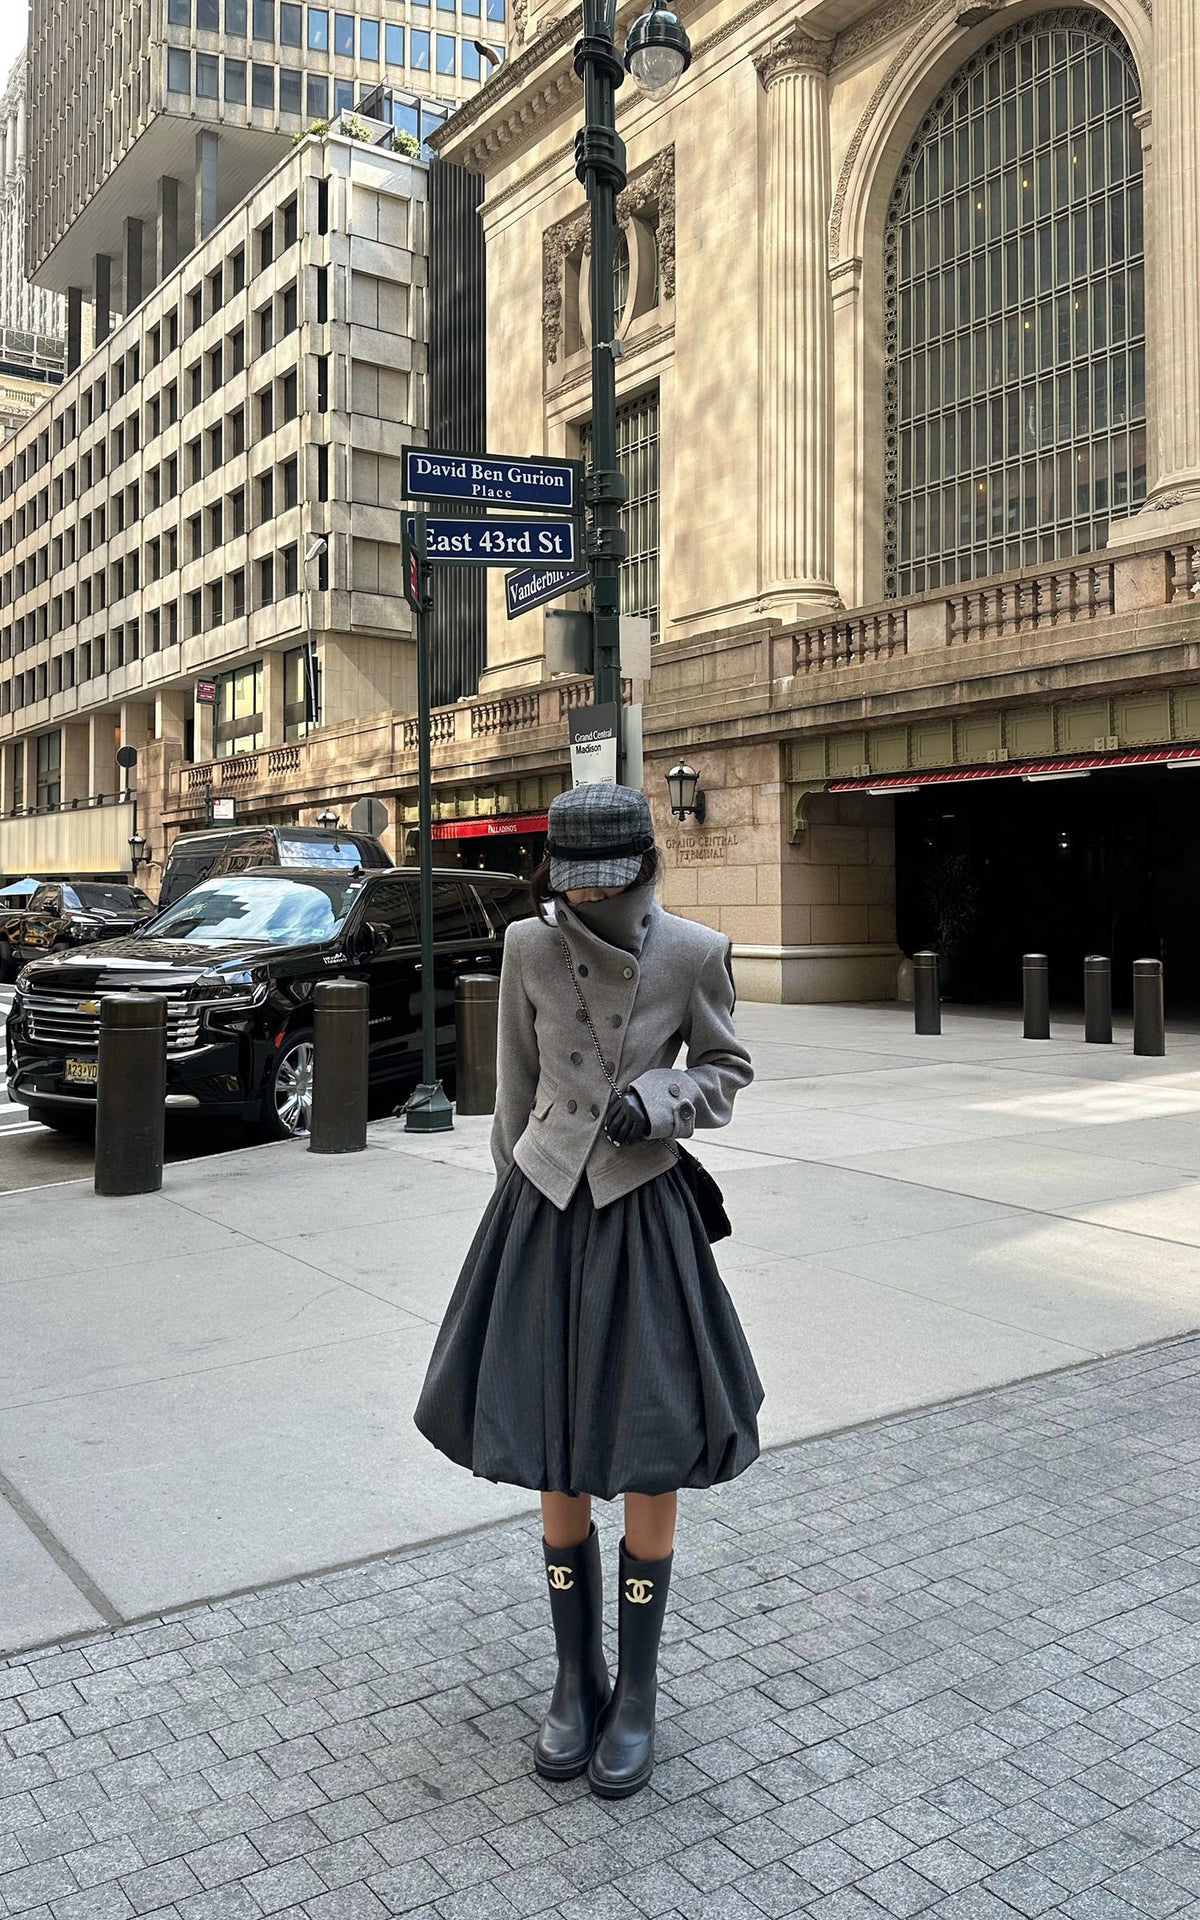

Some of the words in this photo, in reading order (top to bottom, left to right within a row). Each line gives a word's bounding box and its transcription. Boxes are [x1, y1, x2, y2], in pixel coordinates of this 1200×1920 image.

[416, 459, 467, 478] David
[471, 464, 504, 482] Ben
[507, 467, 564, 487] Gurion
[472, 484, 512, 498] Place
[426, 529, 472, 552] East
[479, 531, 532, 553] 43rd
[538, 531, 563, 553] St
[575, 732, 593, 743] Grand
[593, 728, 612, 740] Central
[575, 744, 602, 755] Madison
[665, 837, 696, 849] GRAND
[698, 834, 739, 847] CENTRAL
[679, 848, 725, 862] TERMINAL
